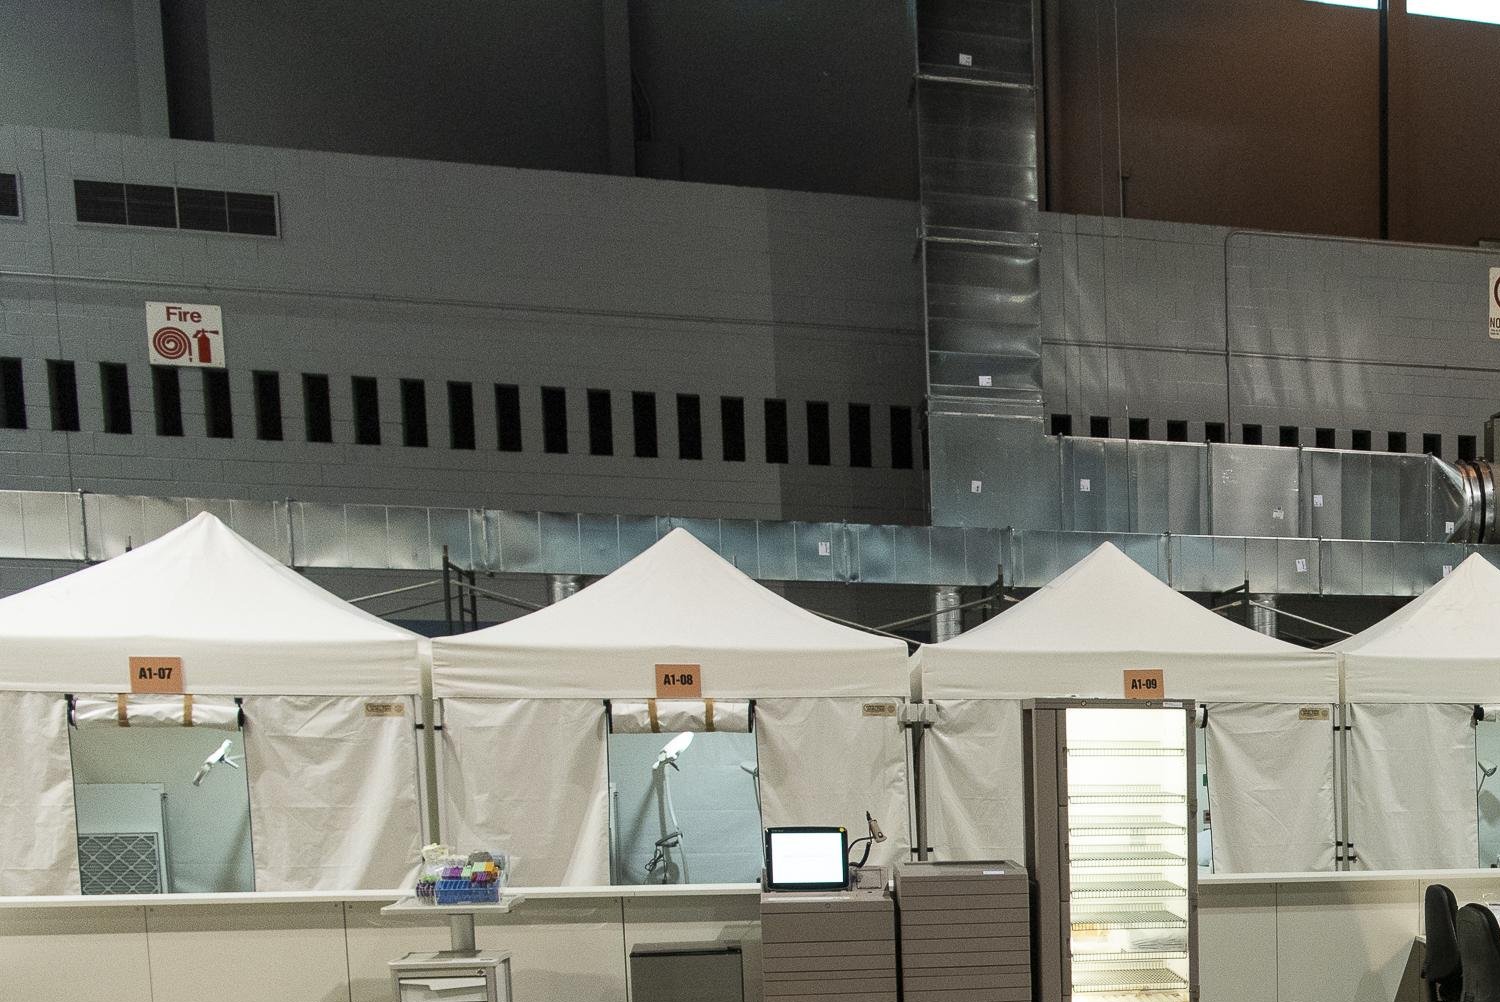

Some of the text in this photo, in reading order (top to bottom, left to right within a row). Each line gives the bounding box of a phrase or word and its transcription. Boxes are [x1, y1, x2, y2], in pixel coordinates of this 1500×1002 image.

[165, 306, 202, 323] Fire
[1489, 317, 1500, 329] NO
[138, 667, 173, 680] A1-07
[663, 673, 694, 686] A1-08
[1131, 678, 1157, 690] A1-09
